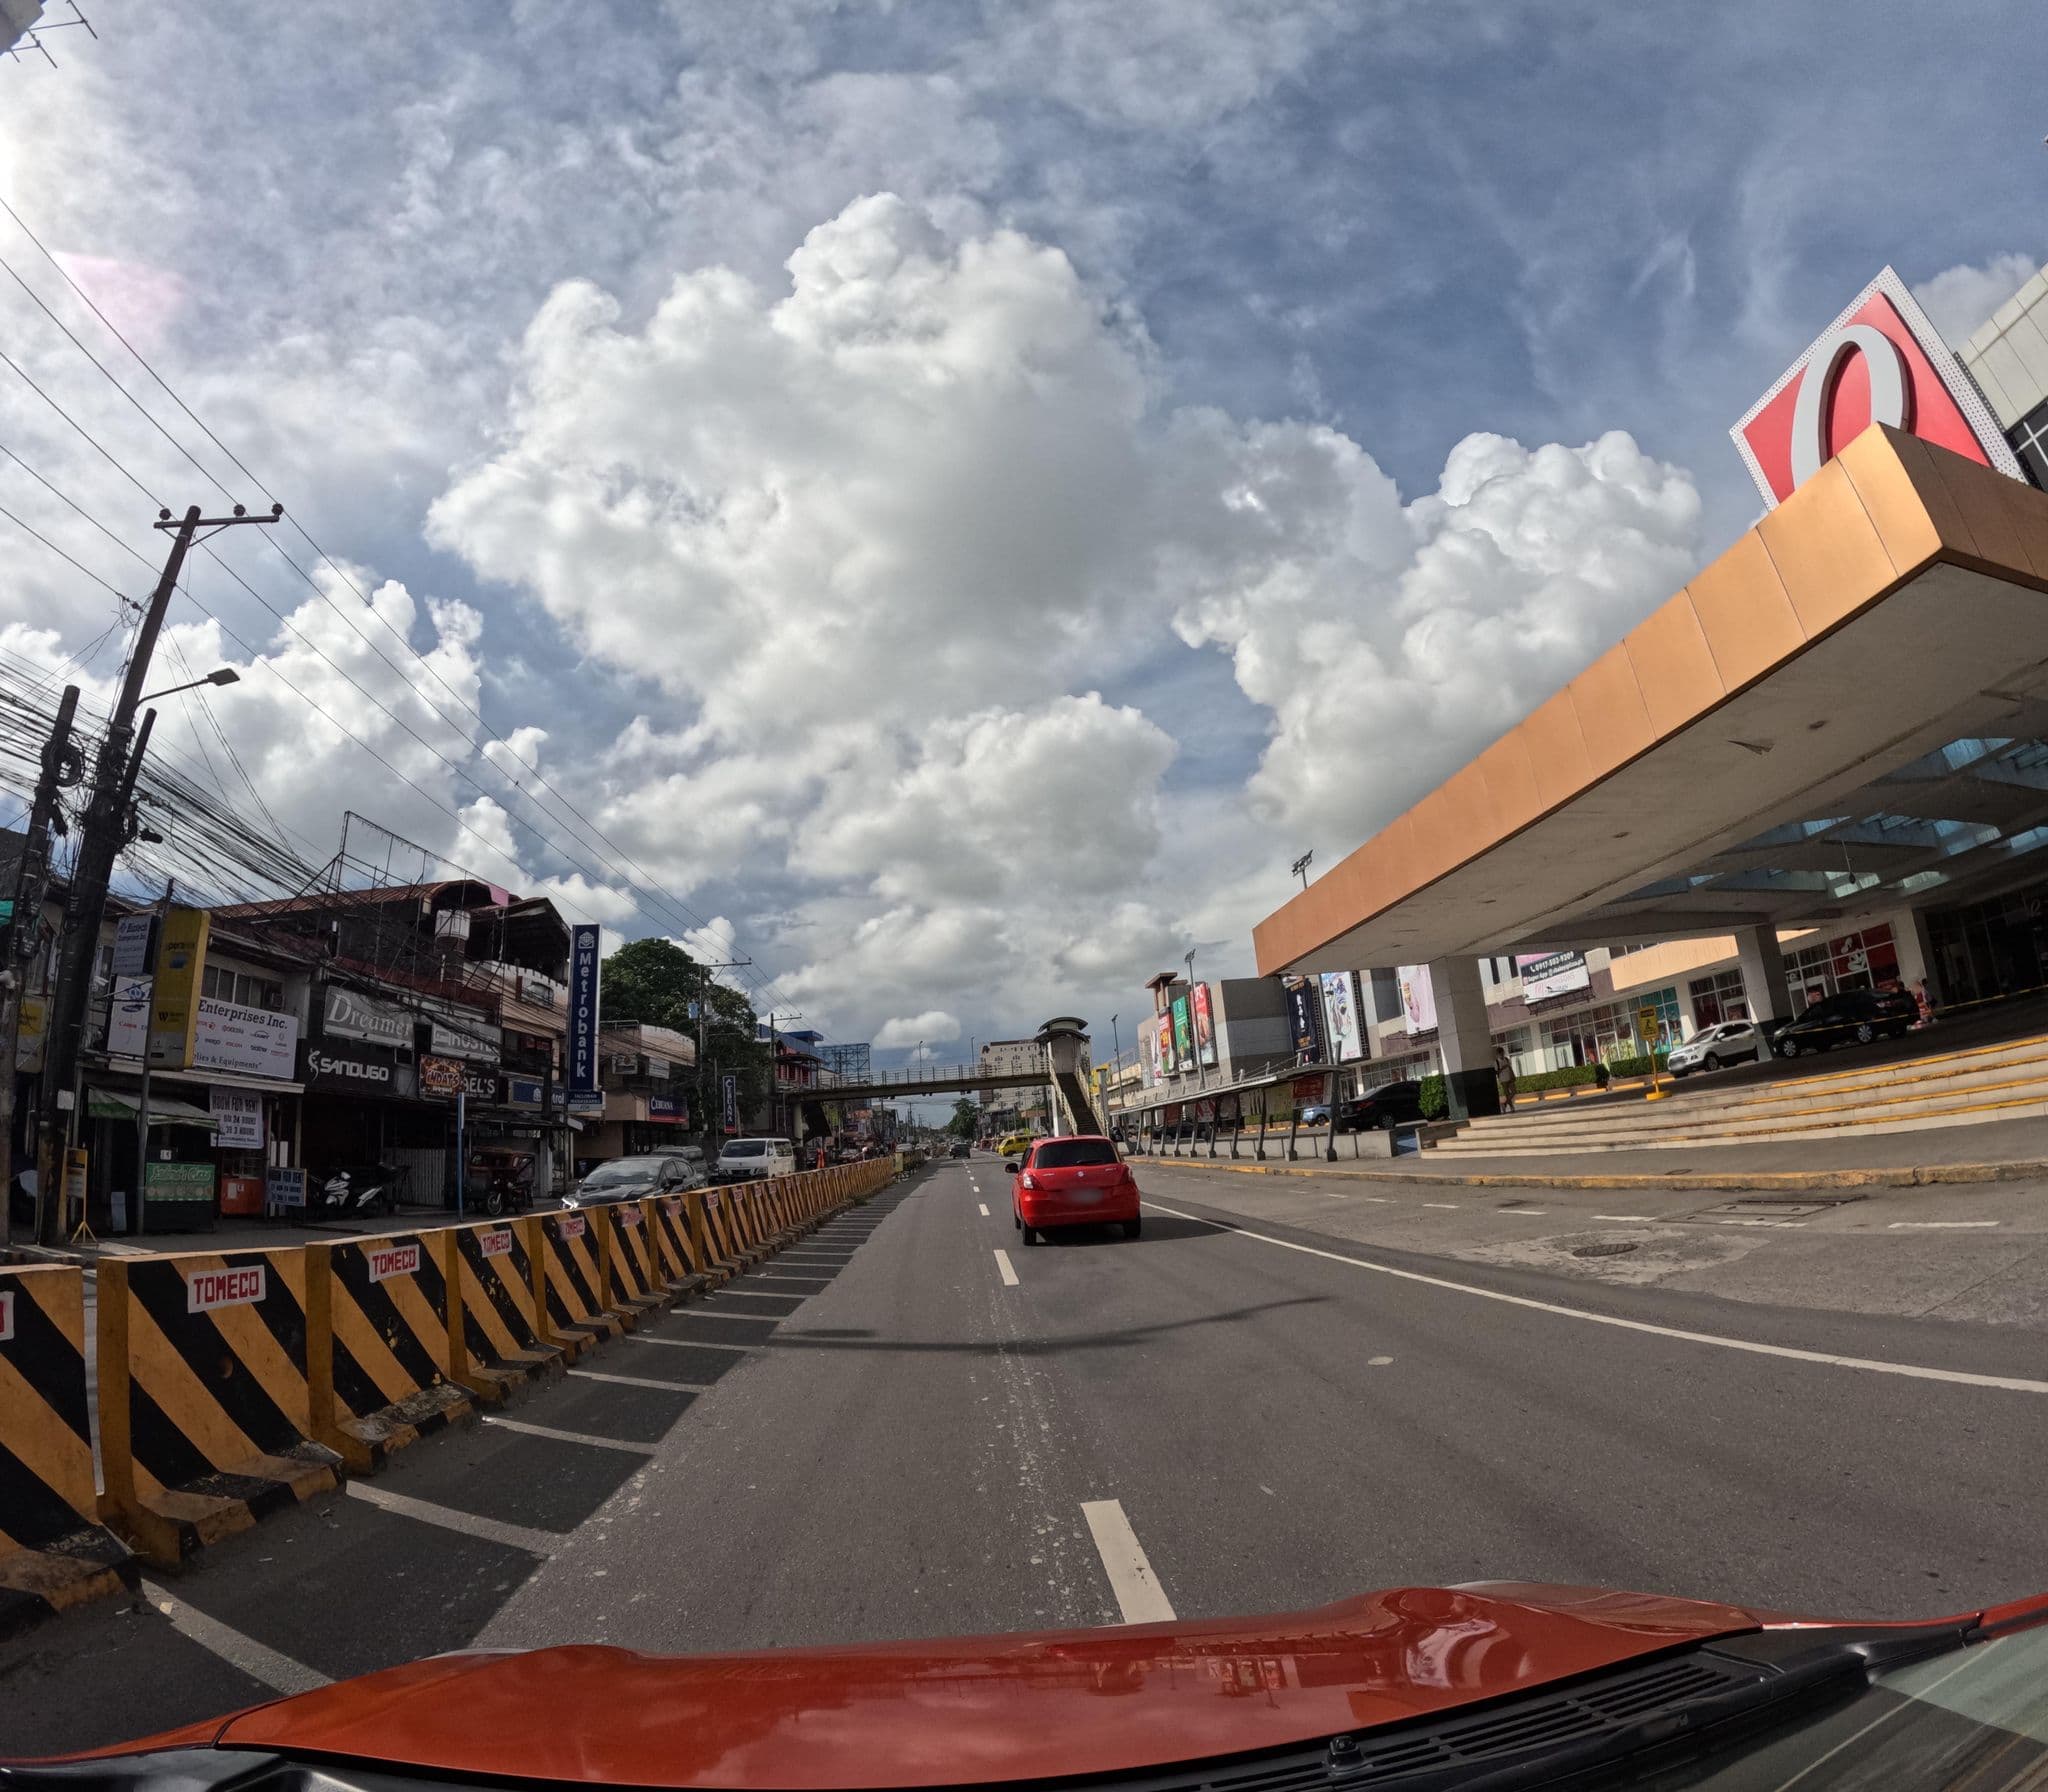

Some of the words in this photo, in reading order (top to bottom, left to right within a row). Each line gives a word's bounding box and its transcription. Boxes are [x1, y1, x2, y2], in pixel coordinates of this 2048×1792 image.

[198, 999, 266, 1025] Enterprises
[267, 1014, 288, 1030] Inc.
[576, 952, 592, 1078] Metrobank
[320, 1057, 390, 1082] SANDUGO
[372, 1249, 417, 1276] TOMECO
[193, 1271, 261, 1305] TOMECO
